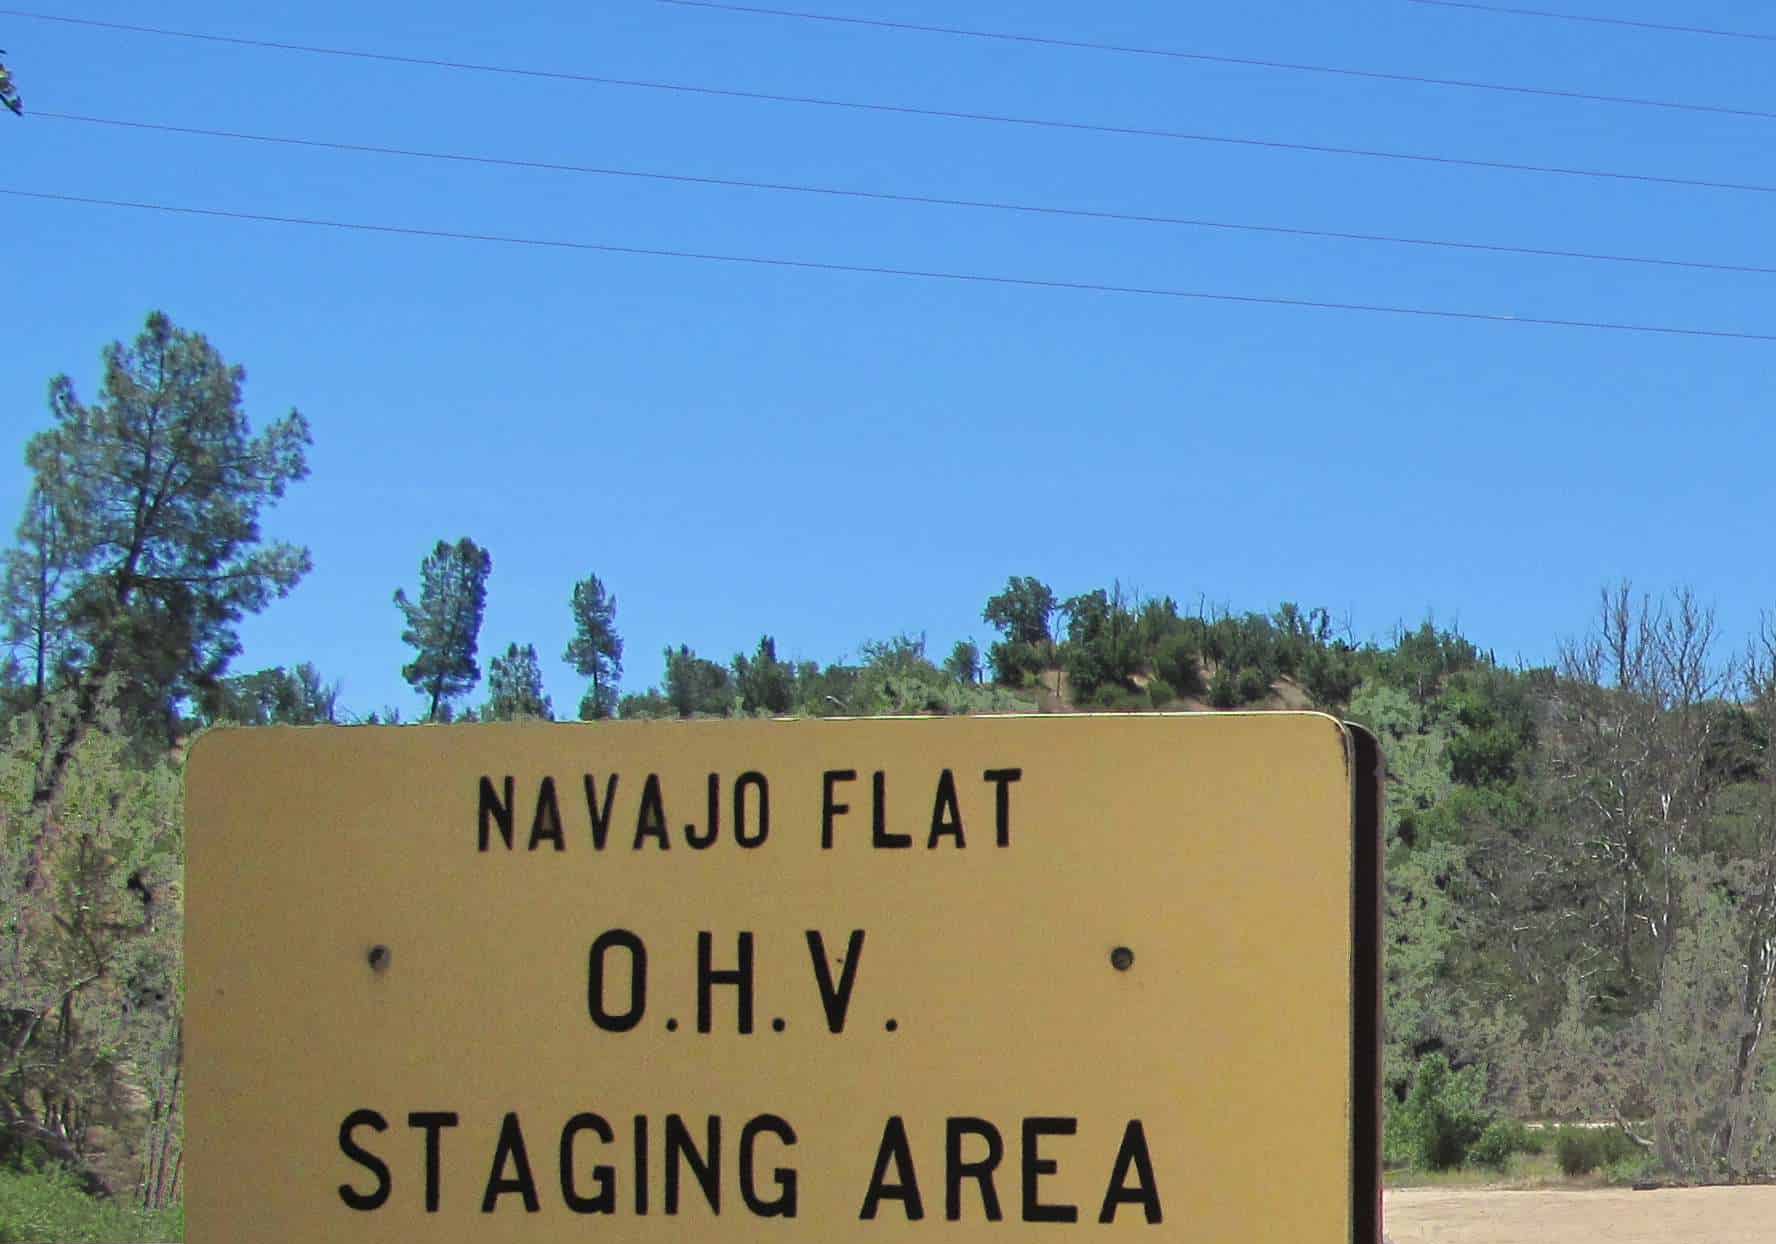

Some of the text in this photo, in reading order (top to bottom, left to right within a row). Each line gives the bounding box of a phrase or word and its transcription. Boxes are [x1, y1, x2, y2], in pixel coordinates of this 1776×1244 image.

[478, 768, 1021, 852] NAVAJO FLAT
[588, 929, 897, 1034] O.H.V.
[338, 1109, 1162, 1224] STAGING AREA
